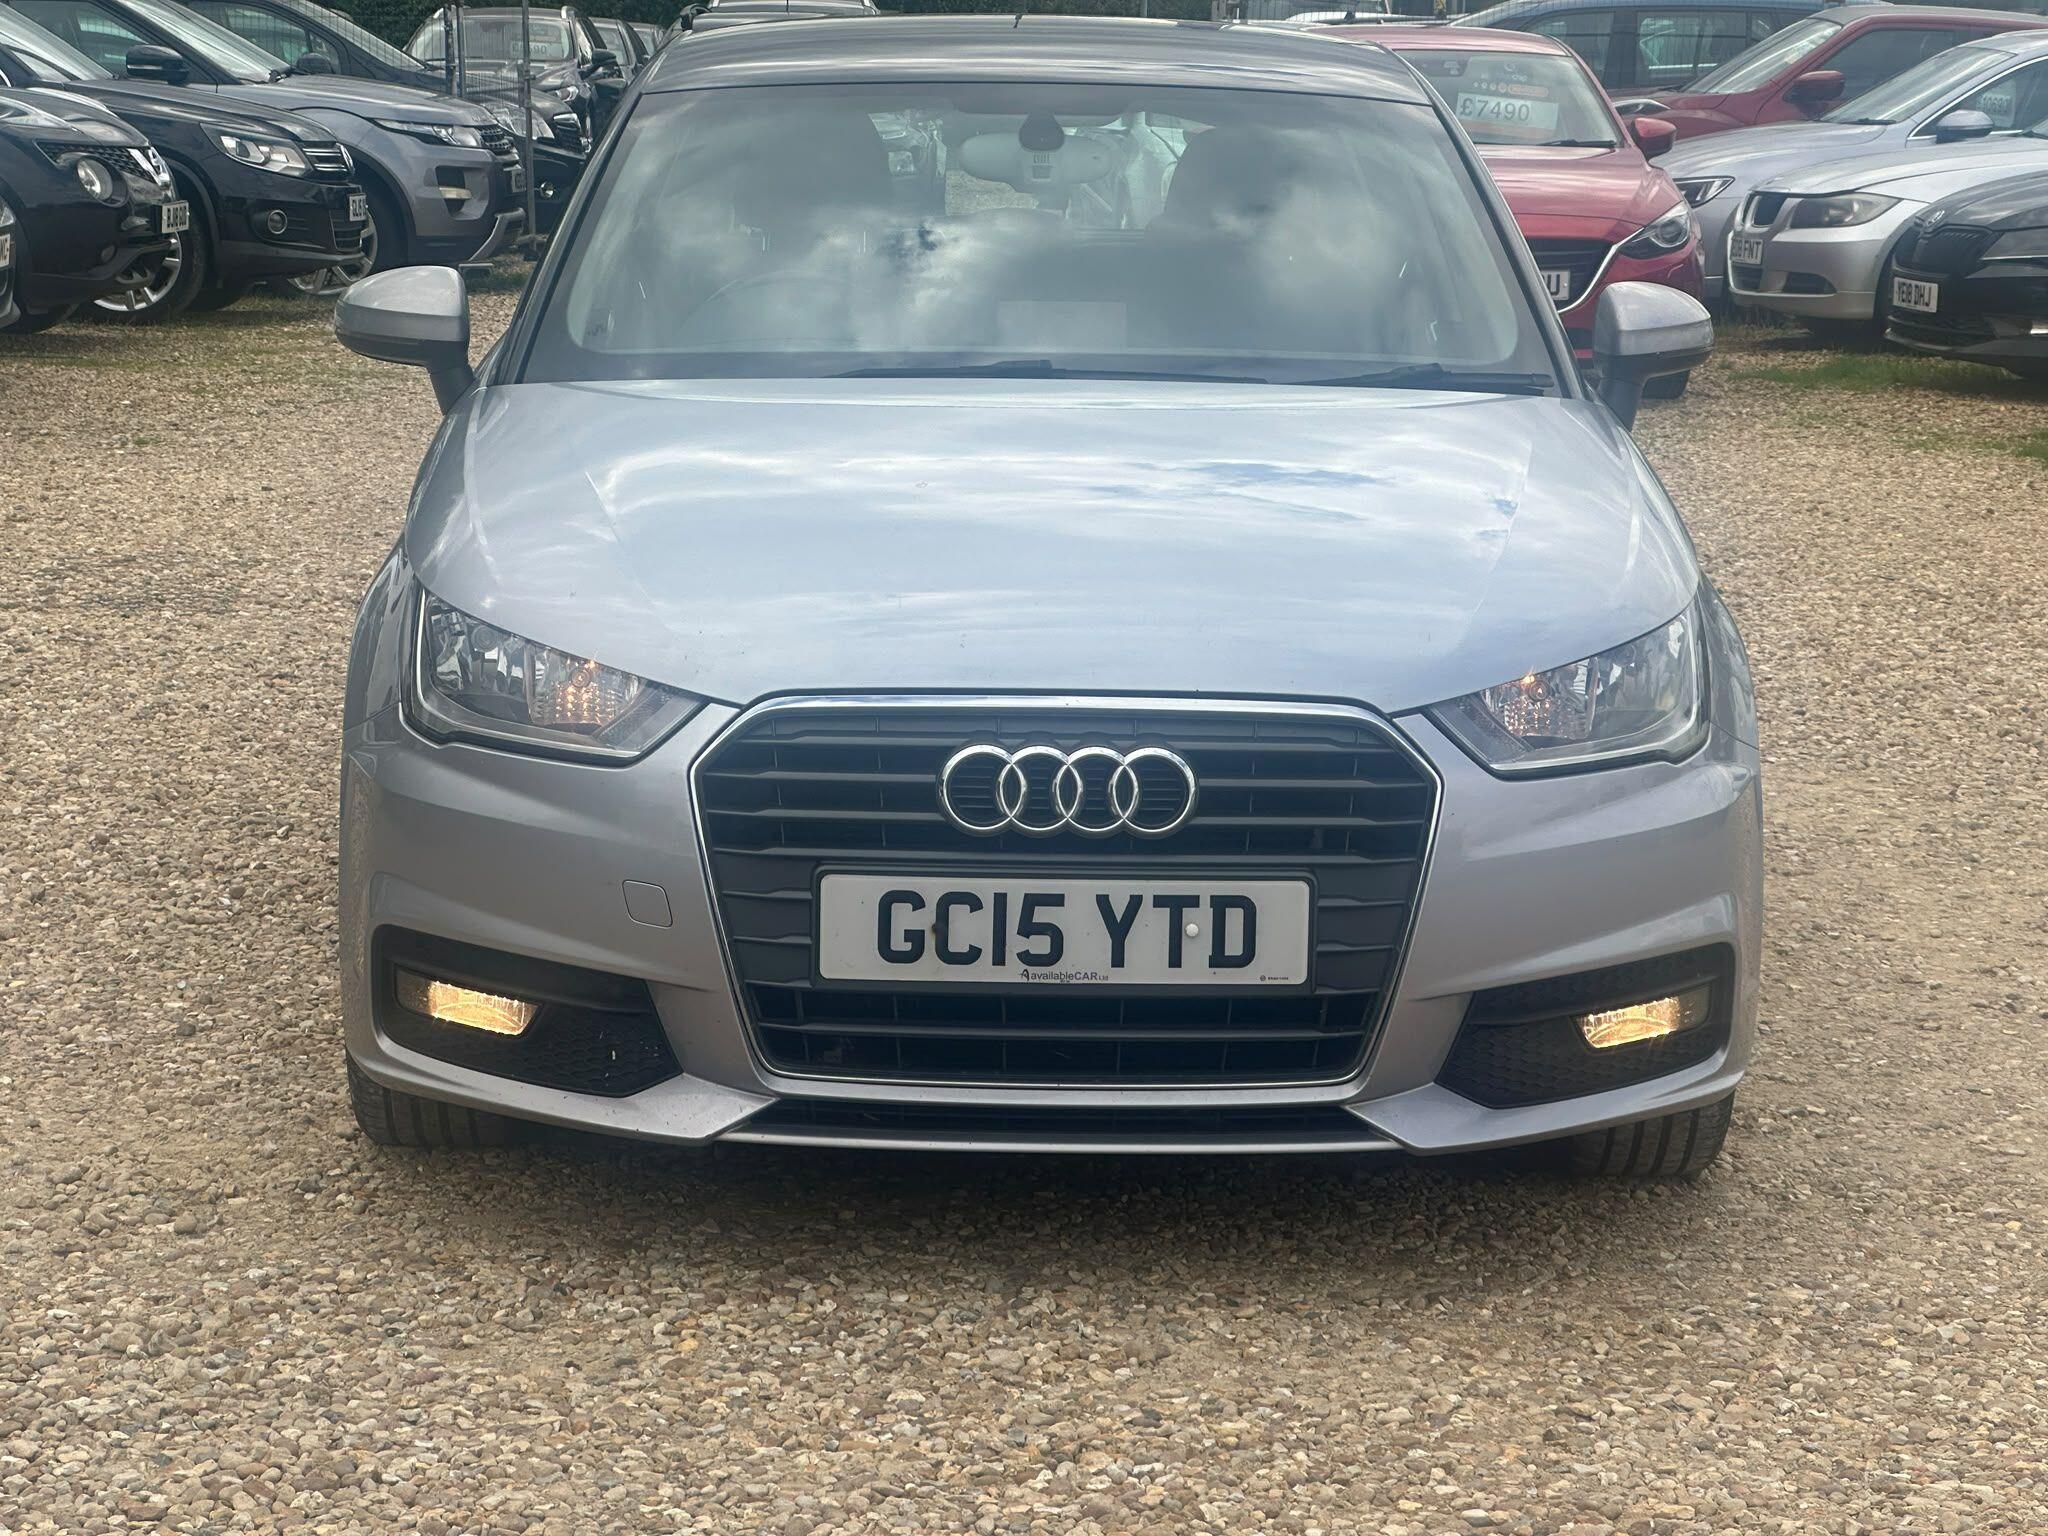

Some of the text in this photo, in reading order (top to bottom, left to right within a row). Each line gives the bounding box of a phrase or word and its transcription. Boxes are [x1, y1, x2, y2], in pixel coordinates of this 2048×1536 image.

[1460, 97, 1530, 121] £7490
[1744, 240, 1762, 259] FNT
[1542, 273, 1560, 297] U
[1914, 284, 1932, 307] DHJ
[877, 889, 1257, 969] GC15 YTD
